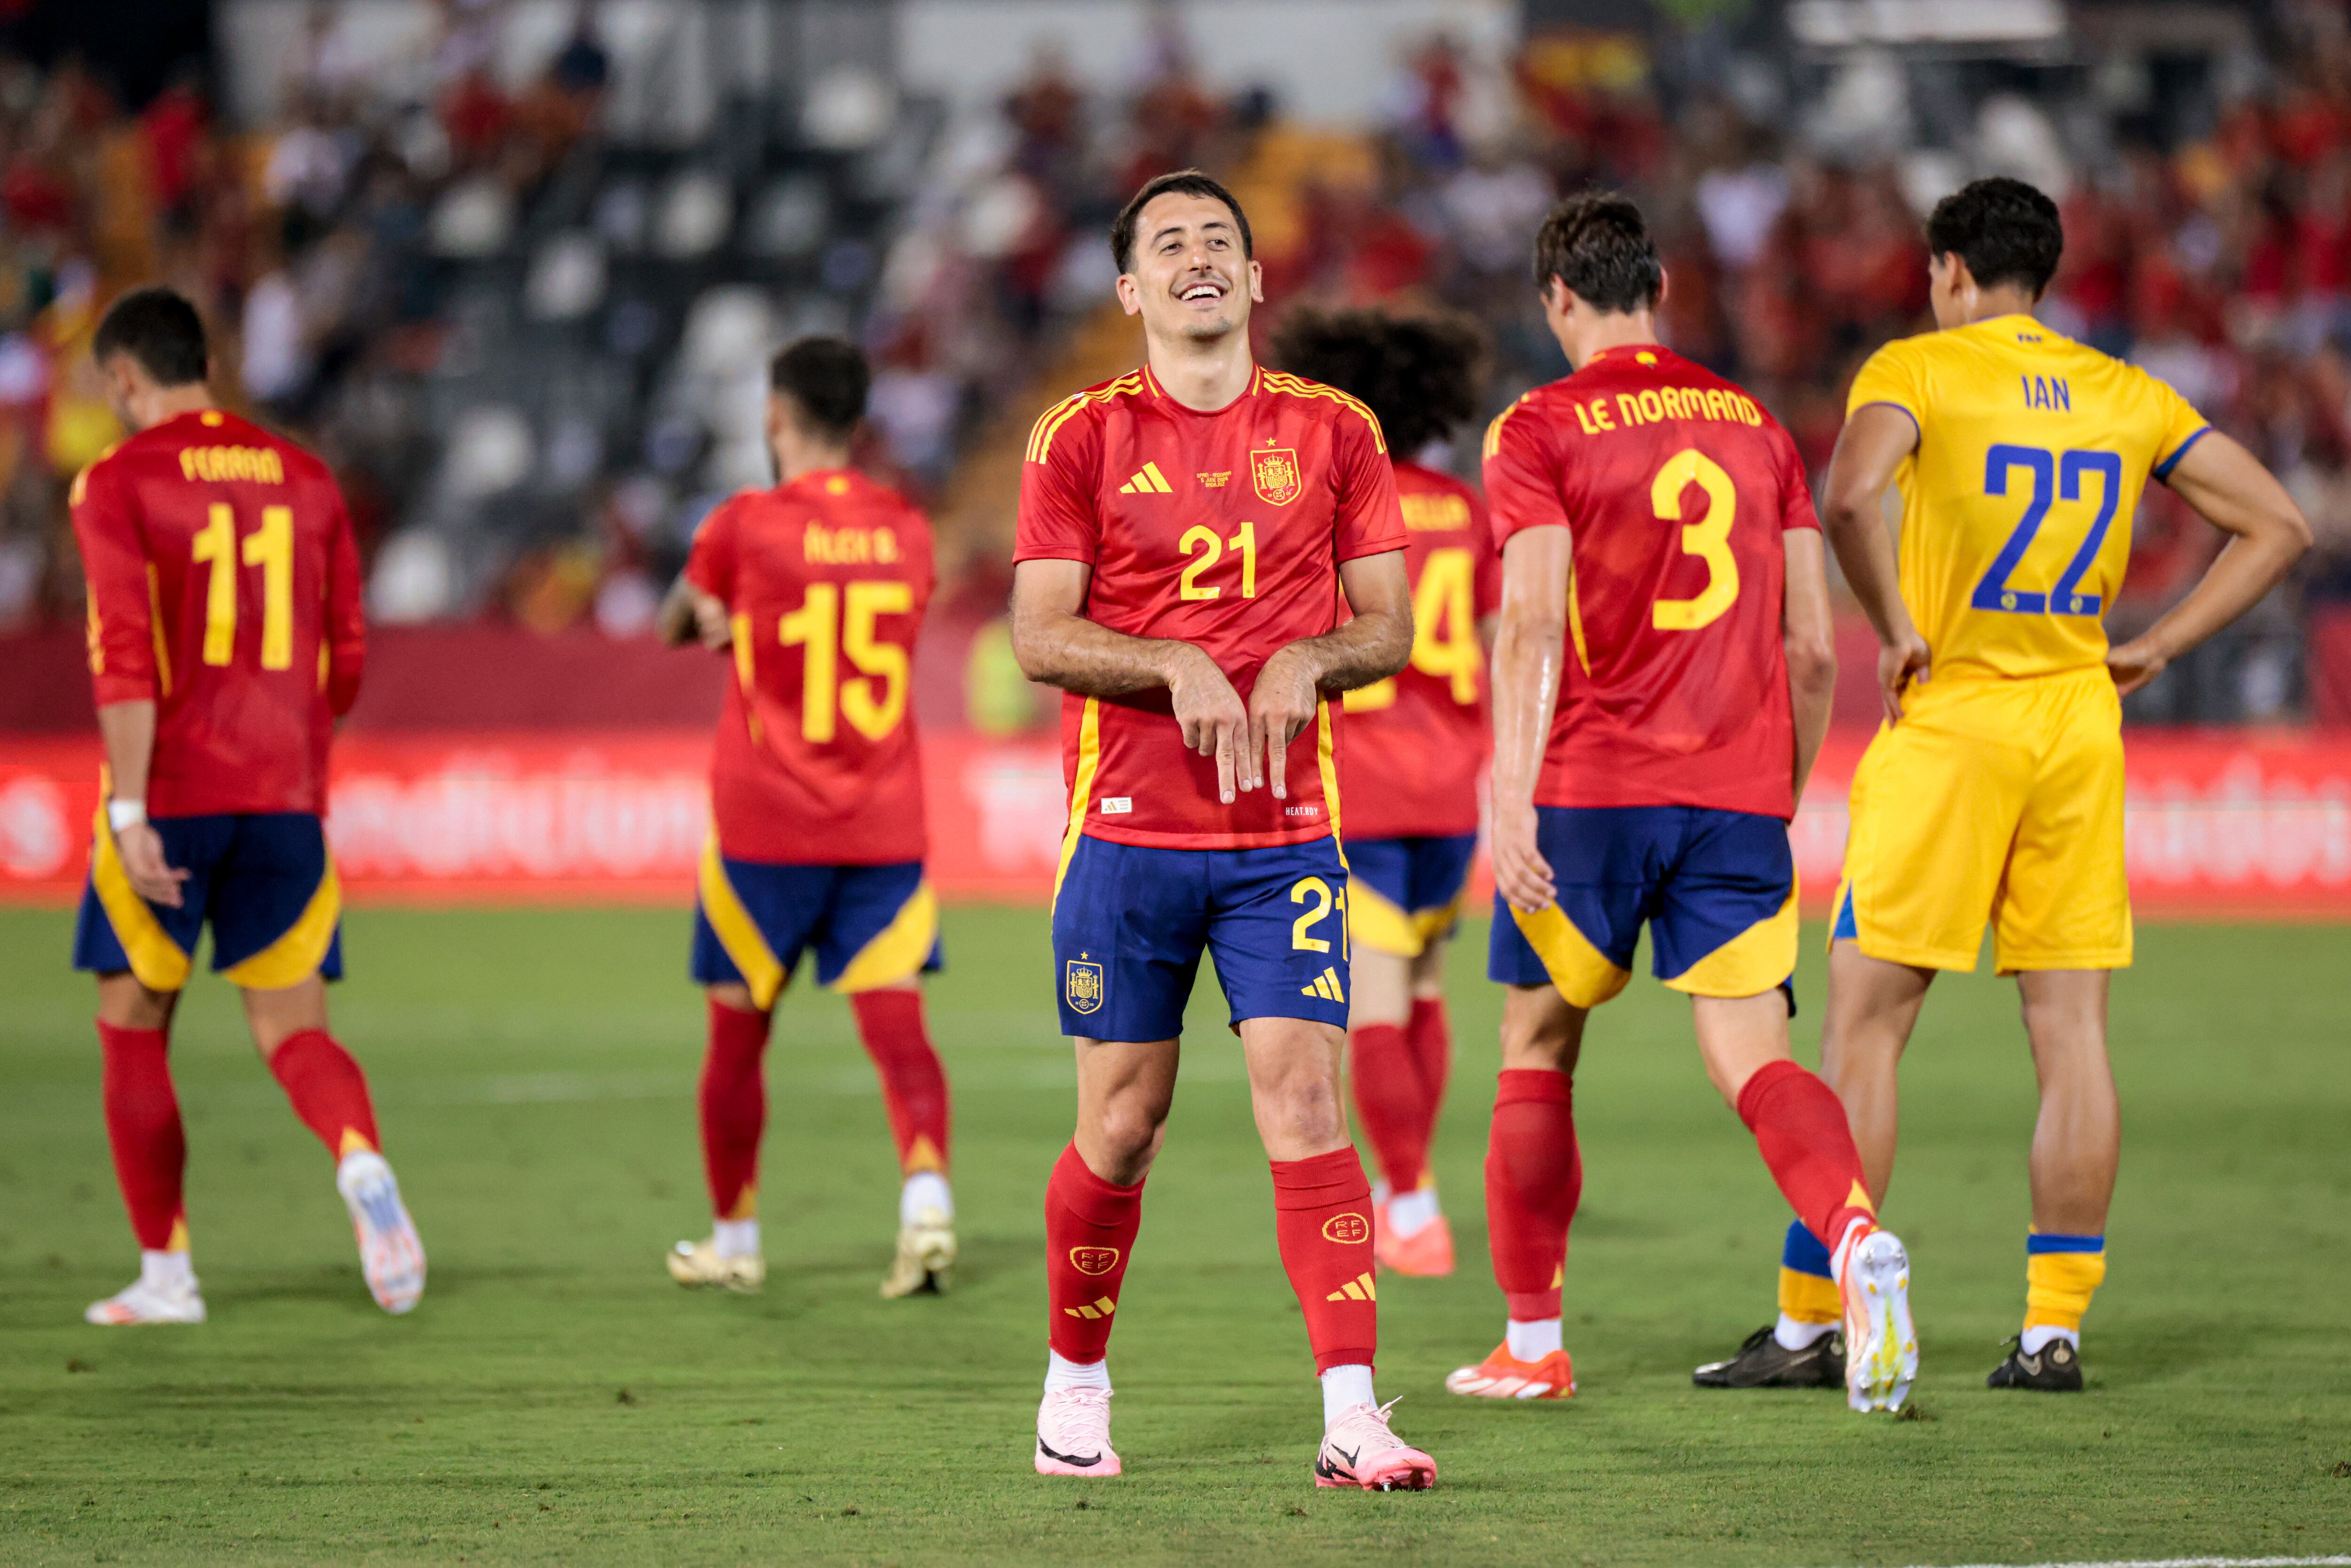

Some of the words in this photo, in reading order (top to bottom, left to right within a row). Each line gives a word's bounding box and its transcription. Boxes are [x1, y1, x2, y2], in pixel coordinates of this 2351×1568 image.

[1574, 398, 1616, 434] LE
[1616, 386, 1762, 427] NORMAND
[2021, 374, 2070, 412] IAN
[1179, 522, 1256, 600] 21
[1650, 448, 1739, 630] 3
[1971, 443, 2122, 616] 22
[193, 502, 293, 670] 11
[778, 581, 913, 743] 15
[1286, 807, 1318, 816] HEAT.RDY
[1291, 876, 1349, 962] 21
